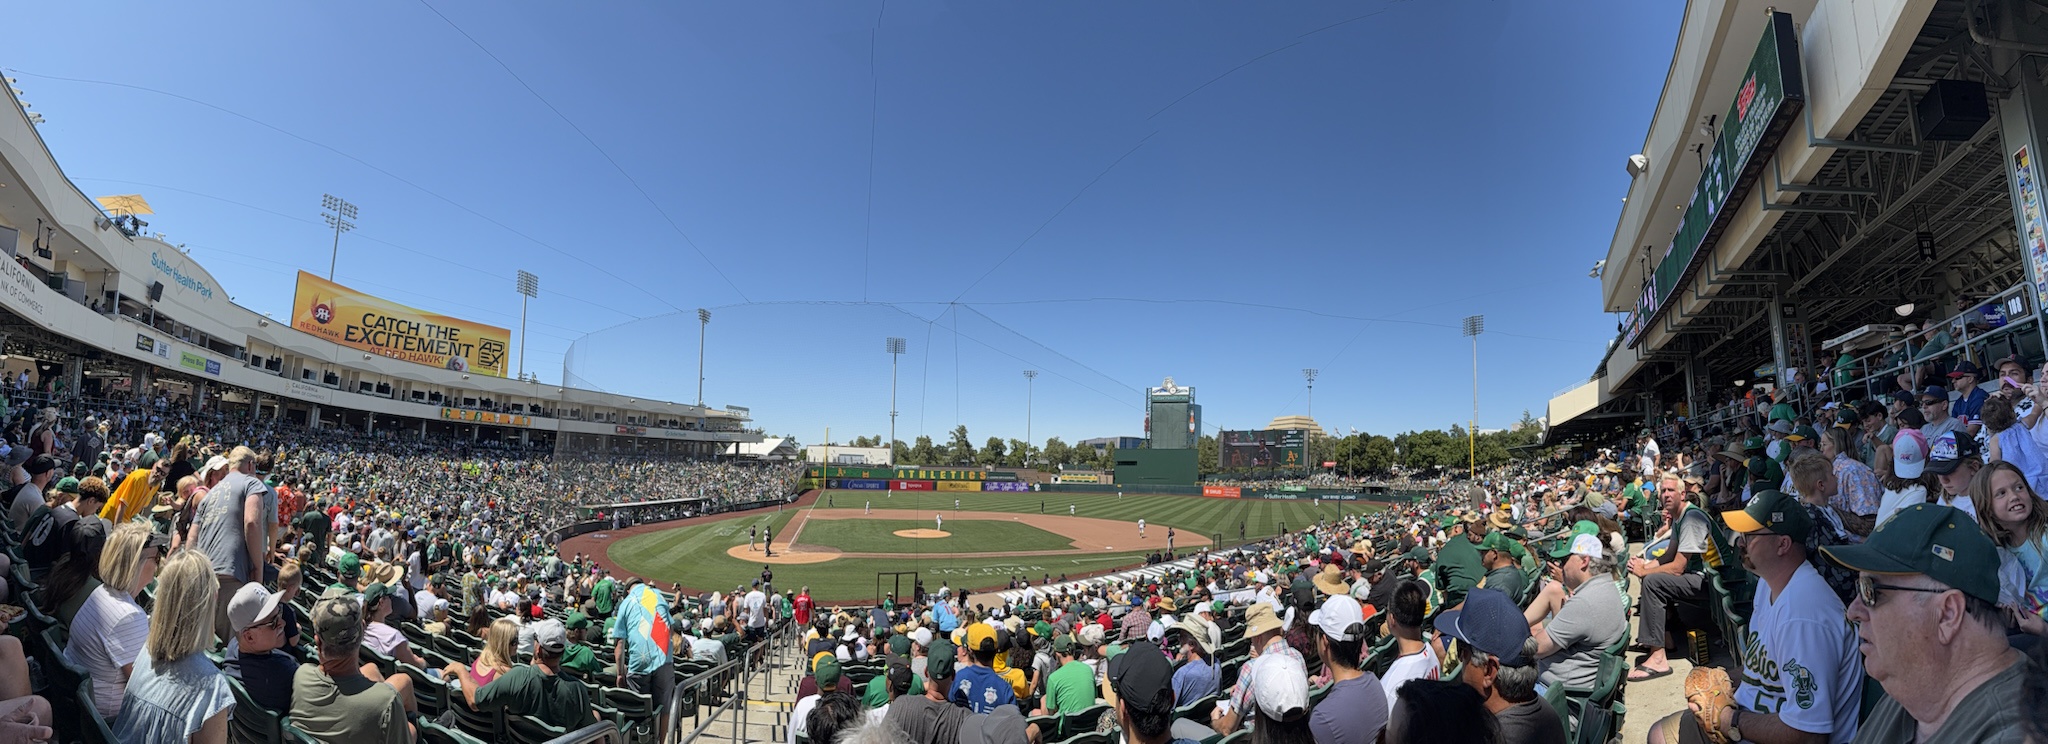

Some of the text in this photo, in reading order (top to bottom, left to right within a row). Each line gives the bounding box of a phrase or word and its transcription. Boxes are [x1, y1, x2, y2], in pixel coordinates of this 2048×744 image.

[1716, 172, 1724, 202] 2
[0, 256, 35, 294] ALIFORNIA
[151, 252, 213, 299] Sutter Health Park
[18, 291, 44, 315] COMMERCE
[2007, 296, 2023, 315] 108
[299, 321, 340, 338] REDHAWK
[362, 313, 461, 341] CATCH THE
[344, 324, 475, 358] EXCITEMENT
[368, 347, 444, 364] AT RED HAWK!
[897, 469, 986, 480] ATHLETICS
